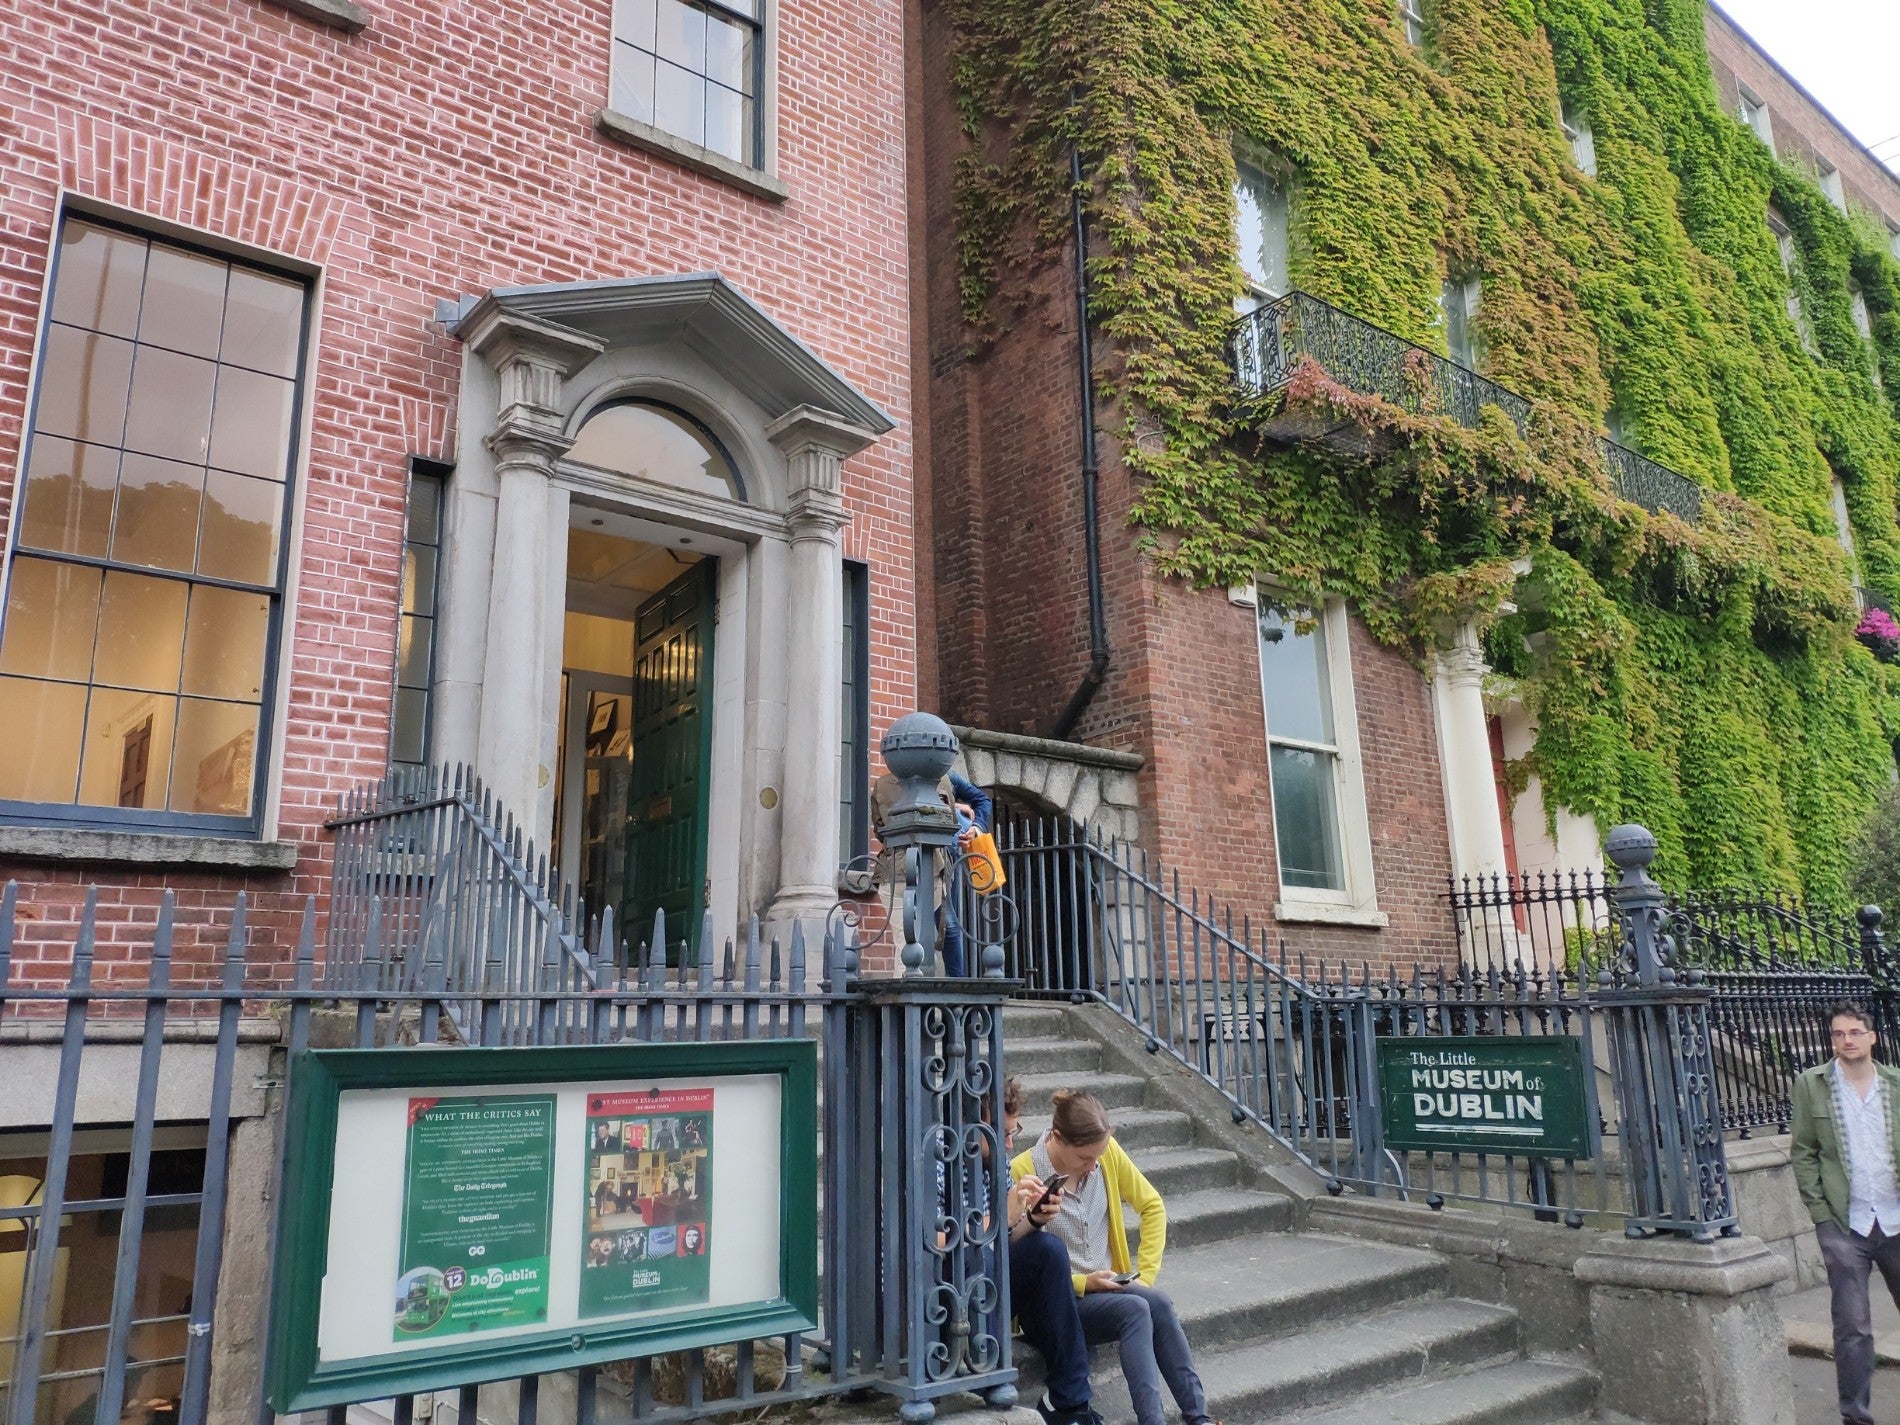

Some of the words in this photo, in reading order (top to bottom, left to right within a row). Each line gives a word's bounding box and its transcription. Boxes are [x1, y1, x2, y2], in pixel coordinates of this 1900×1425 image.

[1410, 1052, 1435, 1067] The
[1439, 1052, 1476, 1066] Little
[1411, 1069, 1524, 1090] MUSEUM
[1526, 1077, 1542, 1091] of
[1413, 1093, 1543, 1121] DUBLIN
[425, 1113, 457, 1121] WHAT
[460, 1112, 481, 1120] THE
[483, 1110, 522, 1119] CRITICS
[524, 1108, 542, 1117] SAY
[454, 1184, 465, 1192] The
[466, 1183, 480, 1192] Daily
[481, 1182, 507, 1191] Telegraph
[459, 1213, 500, 1223] theguardian
[468, 1246, 486, 1256] GQ
[446, 1274, 462, 1289] 12
[470, 1268, 537, 1289] DoDublin
[633, 1276, 660, 1285] DUBLIN
[514, 1285, 541, 1295] explore!
